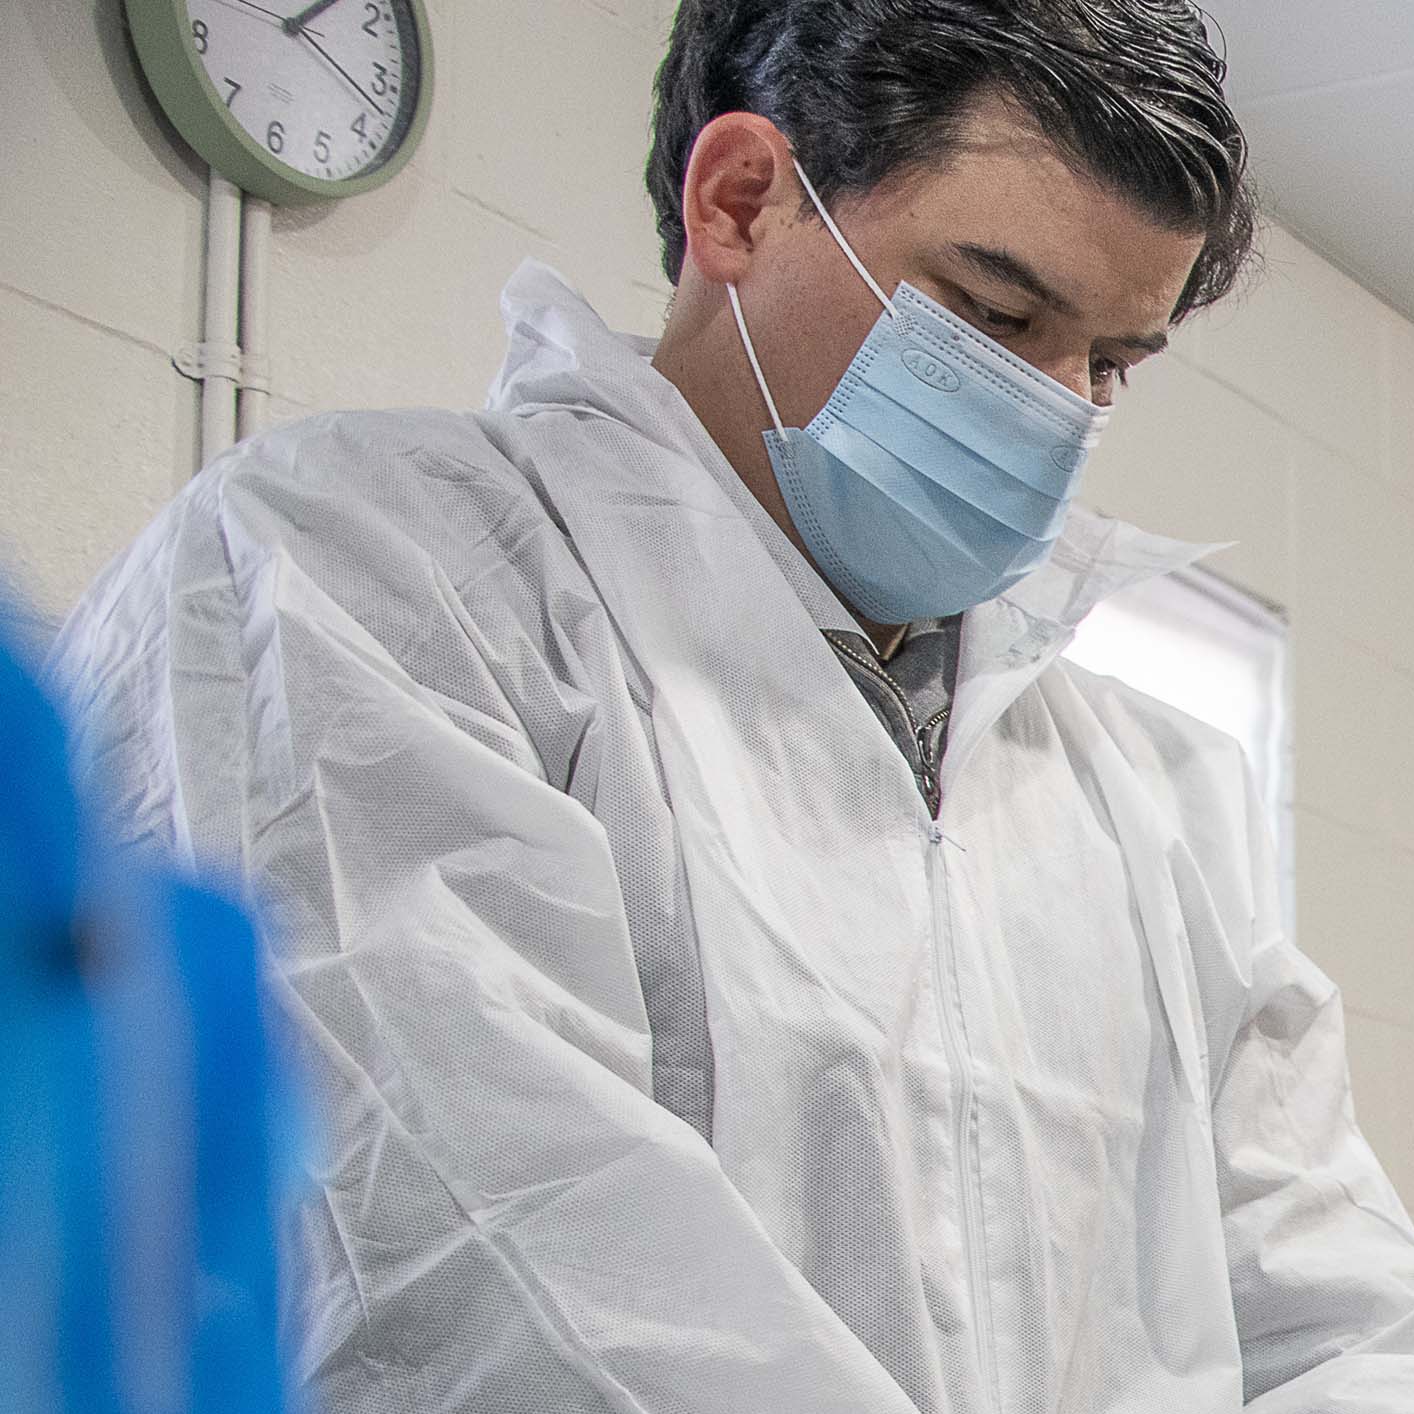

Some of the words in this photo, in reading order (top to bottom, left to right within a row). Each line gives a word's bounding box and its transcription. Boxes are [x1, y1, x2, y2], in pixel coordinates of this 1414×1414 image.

[192, 19, 208, 54] 8
[362, 2, 380, 38] 2
[224, 76, 241, 108] 7
[371, 61, 387, 96] 3
[267, 120, 286, 154] 6
[350, 112, 367, 143] 4
[313, 130, 331, 164] 5
